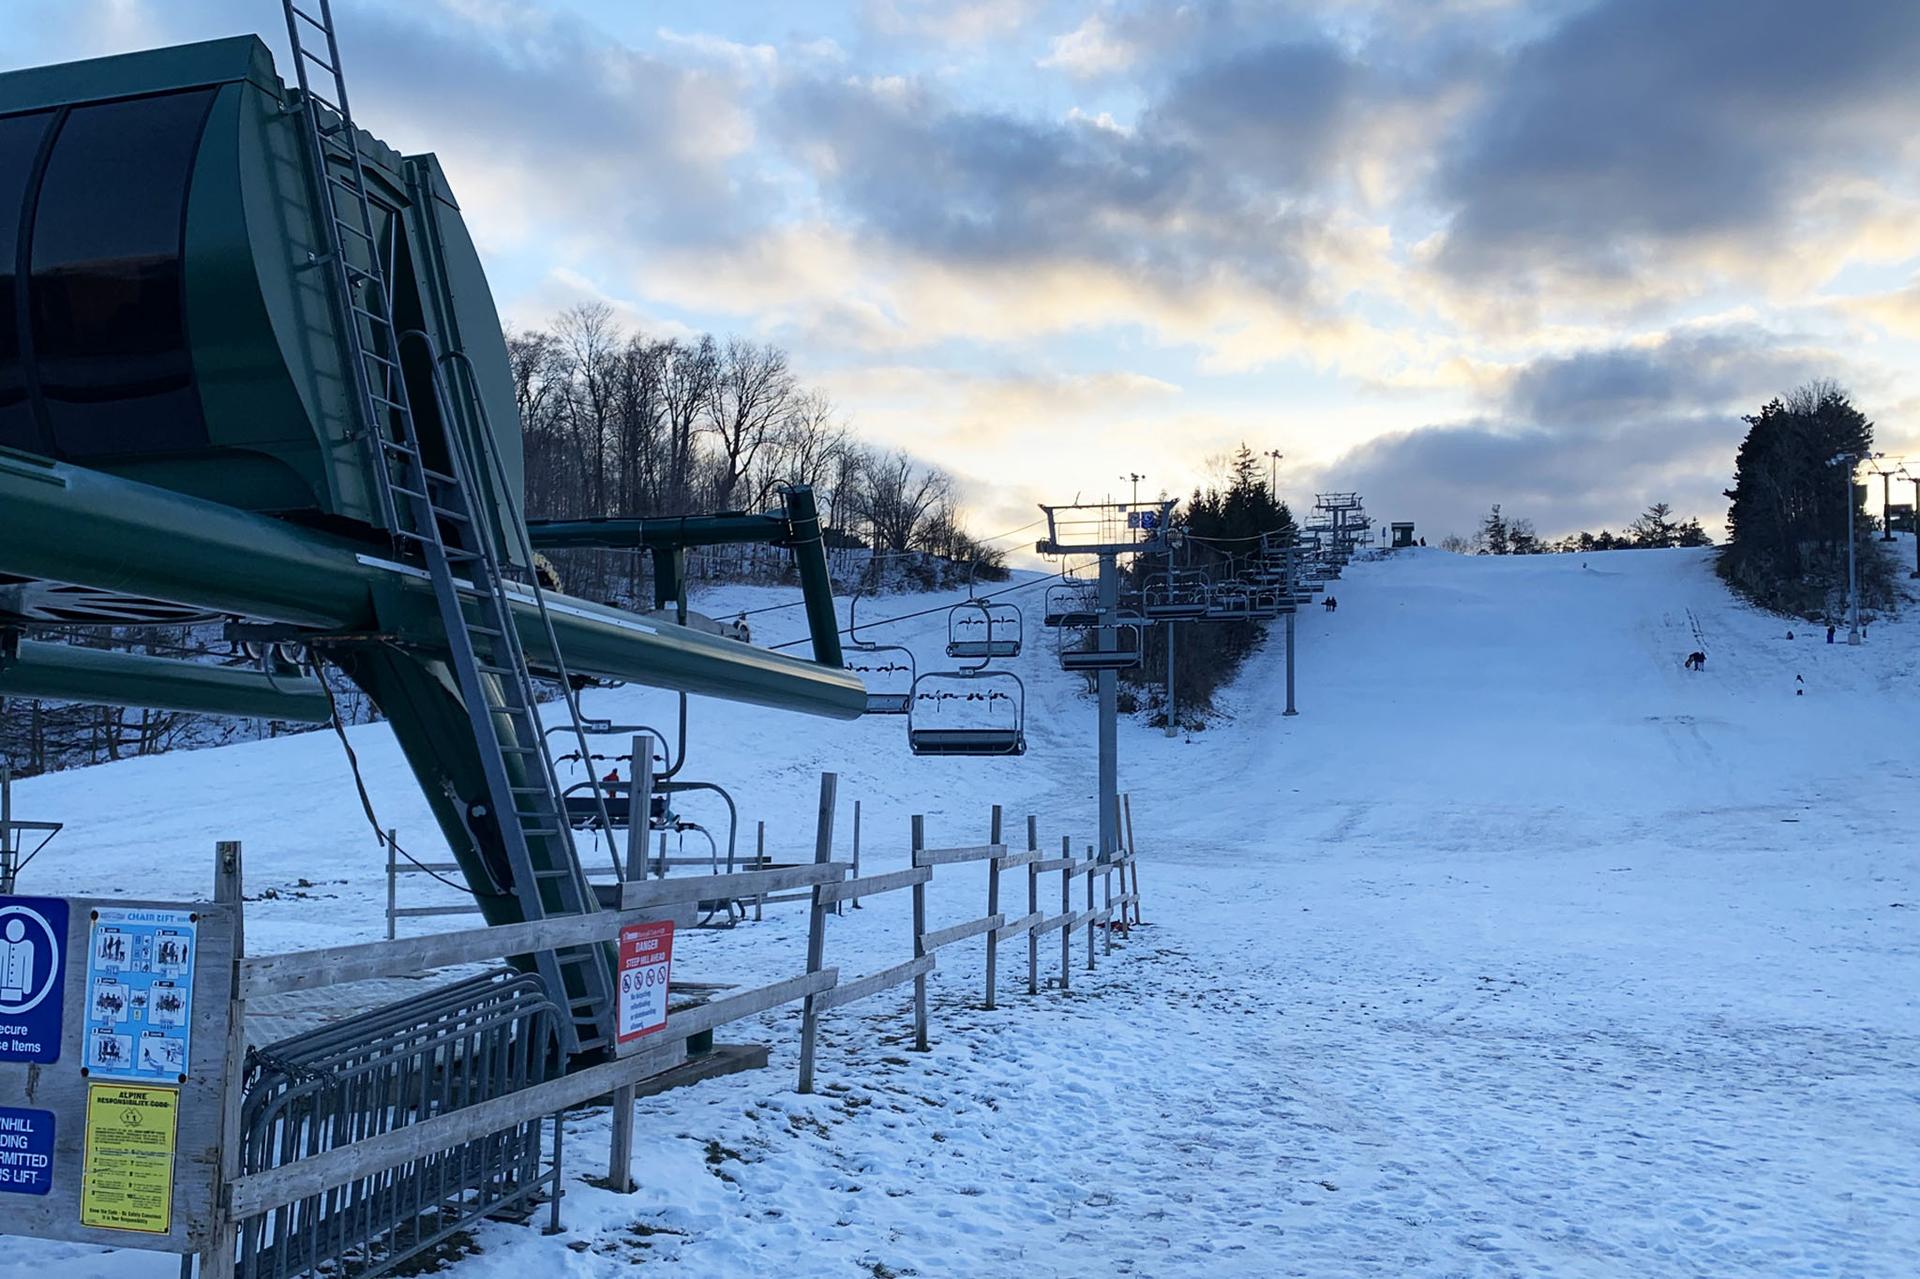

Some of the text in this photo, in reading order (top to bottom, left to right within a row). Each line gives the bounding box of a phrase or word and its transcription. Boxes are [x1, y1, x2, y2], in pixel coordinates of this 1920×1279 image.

[128, 913, 155, 921] CHAIR
[635, 939, 658, 952] DANGER
[12, 1039, 41, 1053] Items
[97, 1097, 149, 1106] RESPONSIBILITY
[119, 1091, 147, 1099] ALPINE
[0, 1117, 34, 1132] NHILL
[0, 1134, 28, 1149] DING
[13, 1169, 38, 1184] LIFT
